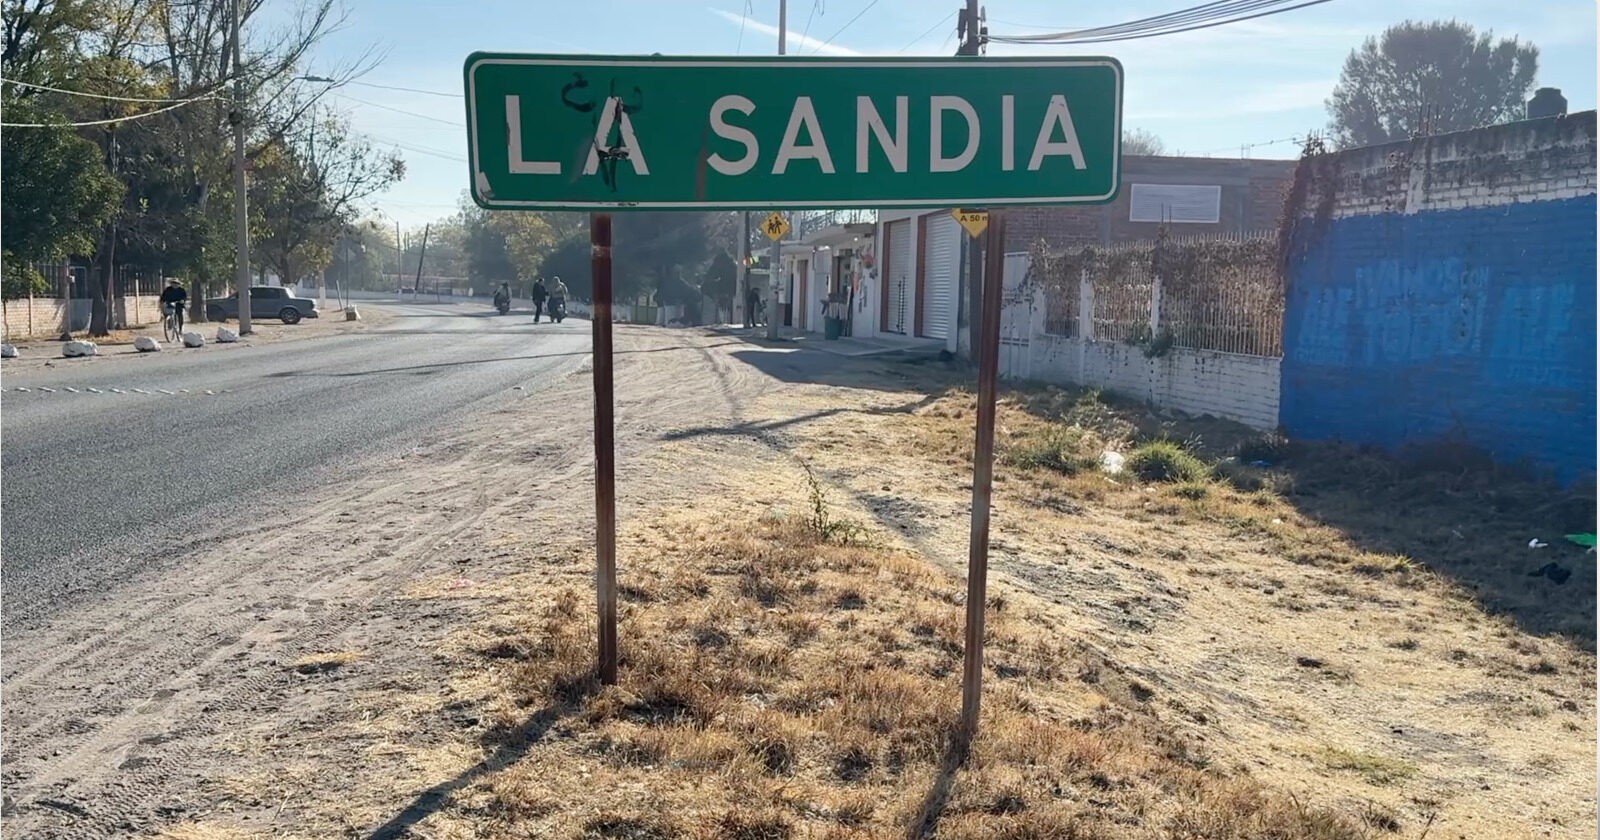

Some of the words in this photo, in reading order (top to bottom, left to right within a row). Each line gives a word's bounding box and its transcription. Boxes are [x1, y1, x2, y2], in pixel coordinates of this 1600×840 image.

[504, 94, 650, 176] LA
[706, 93, 1088, 176] SANDIA
[960, 214, 968, 222] A
[969, 214, 980, 222] 50
